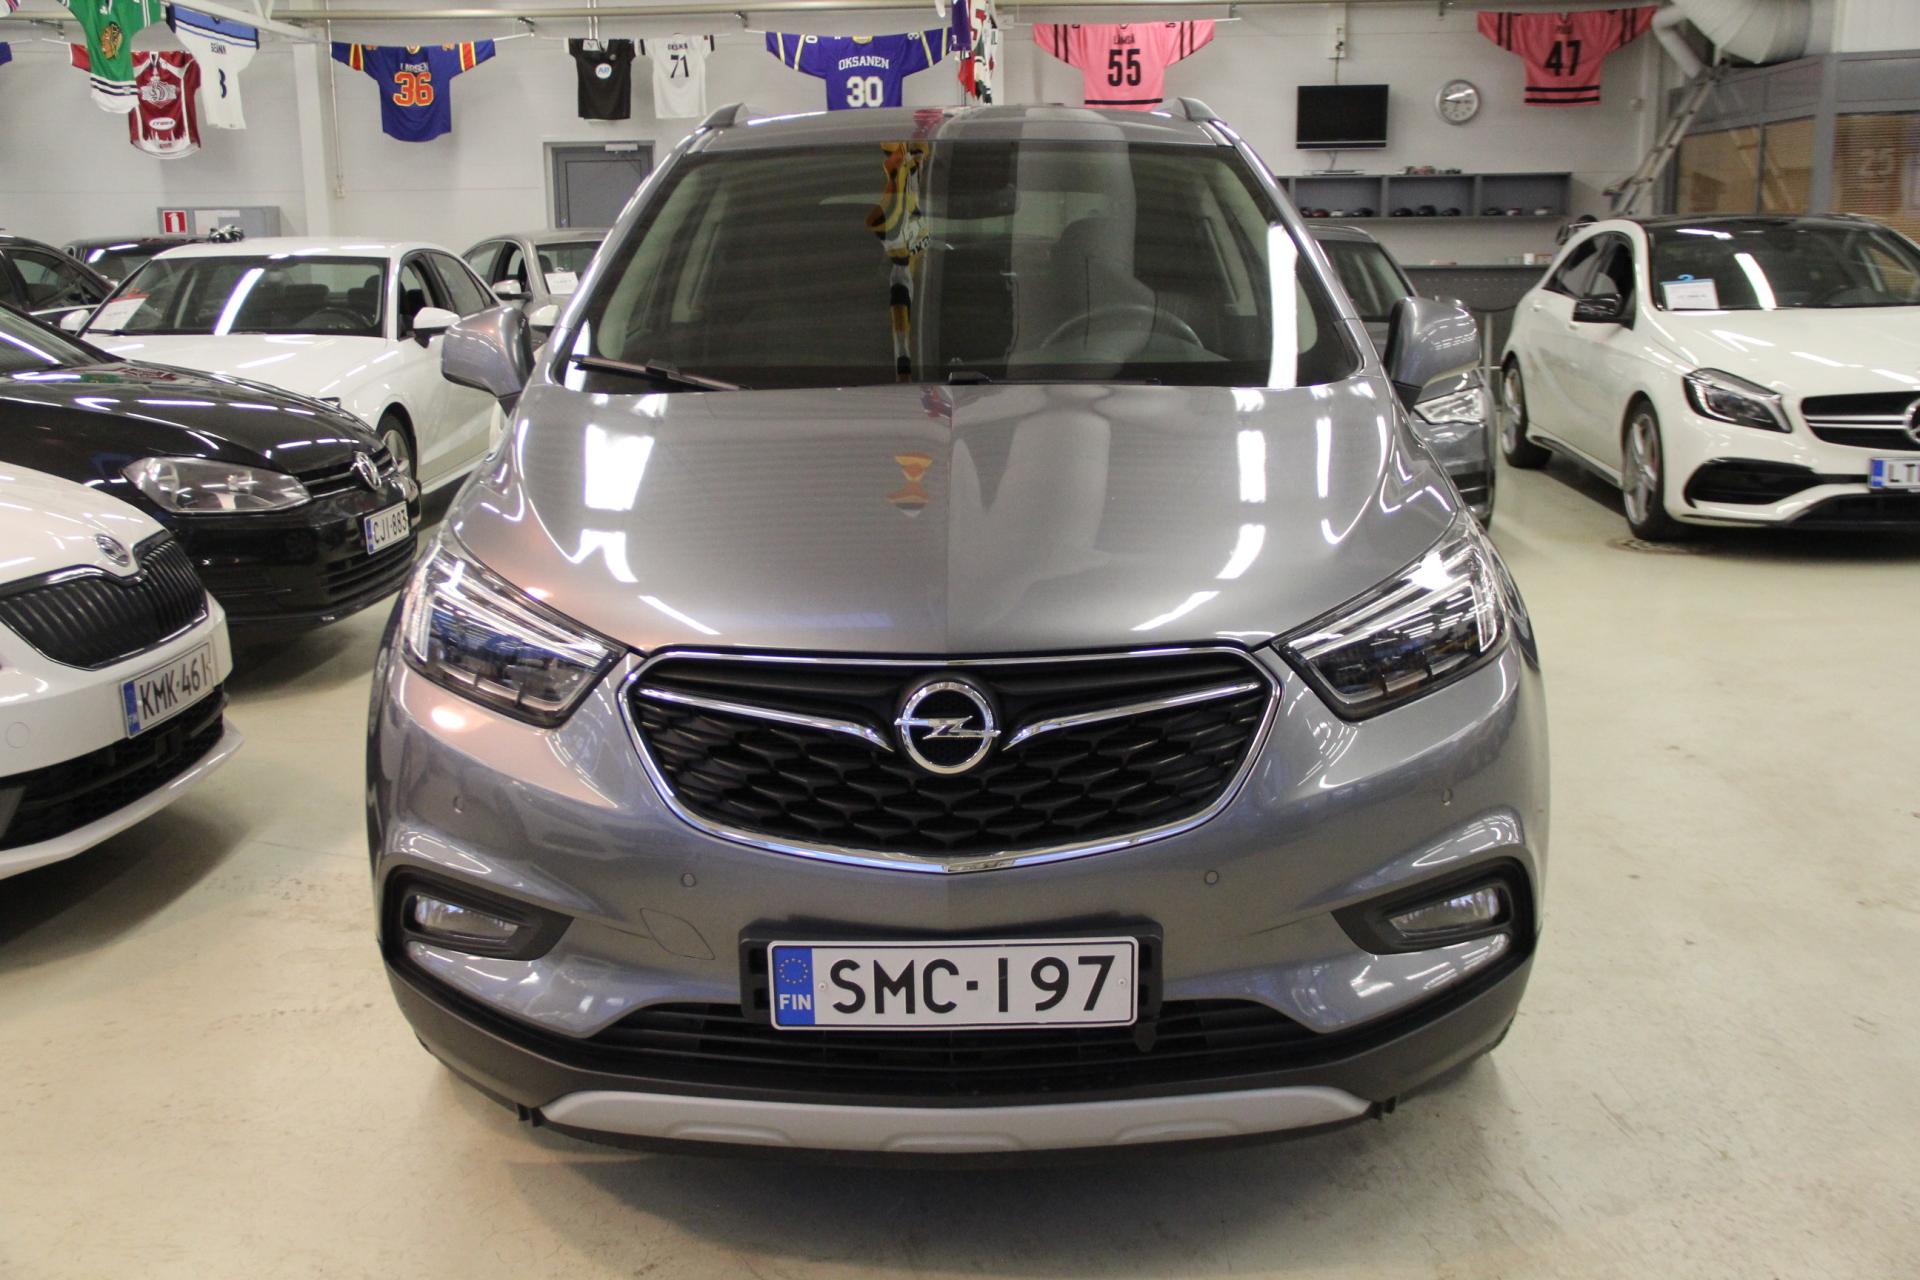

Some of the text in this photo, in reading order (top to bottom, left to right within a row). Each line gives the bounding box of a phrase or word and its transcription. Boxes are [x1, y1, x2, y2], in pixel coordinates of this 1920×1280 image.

[670, 54, 689, 78] 71
[838, 55, 889, 71] OKSANEN
[1107, 48, 1141, 87] 55
[1543, 39, 1582, 77] 47
[393, 71, 434, 107] 36
[846, 75, 883, 108] 30
[779, 993, 812, 1010] FIN
[829, 954, 1116, 1015] SMC-197
